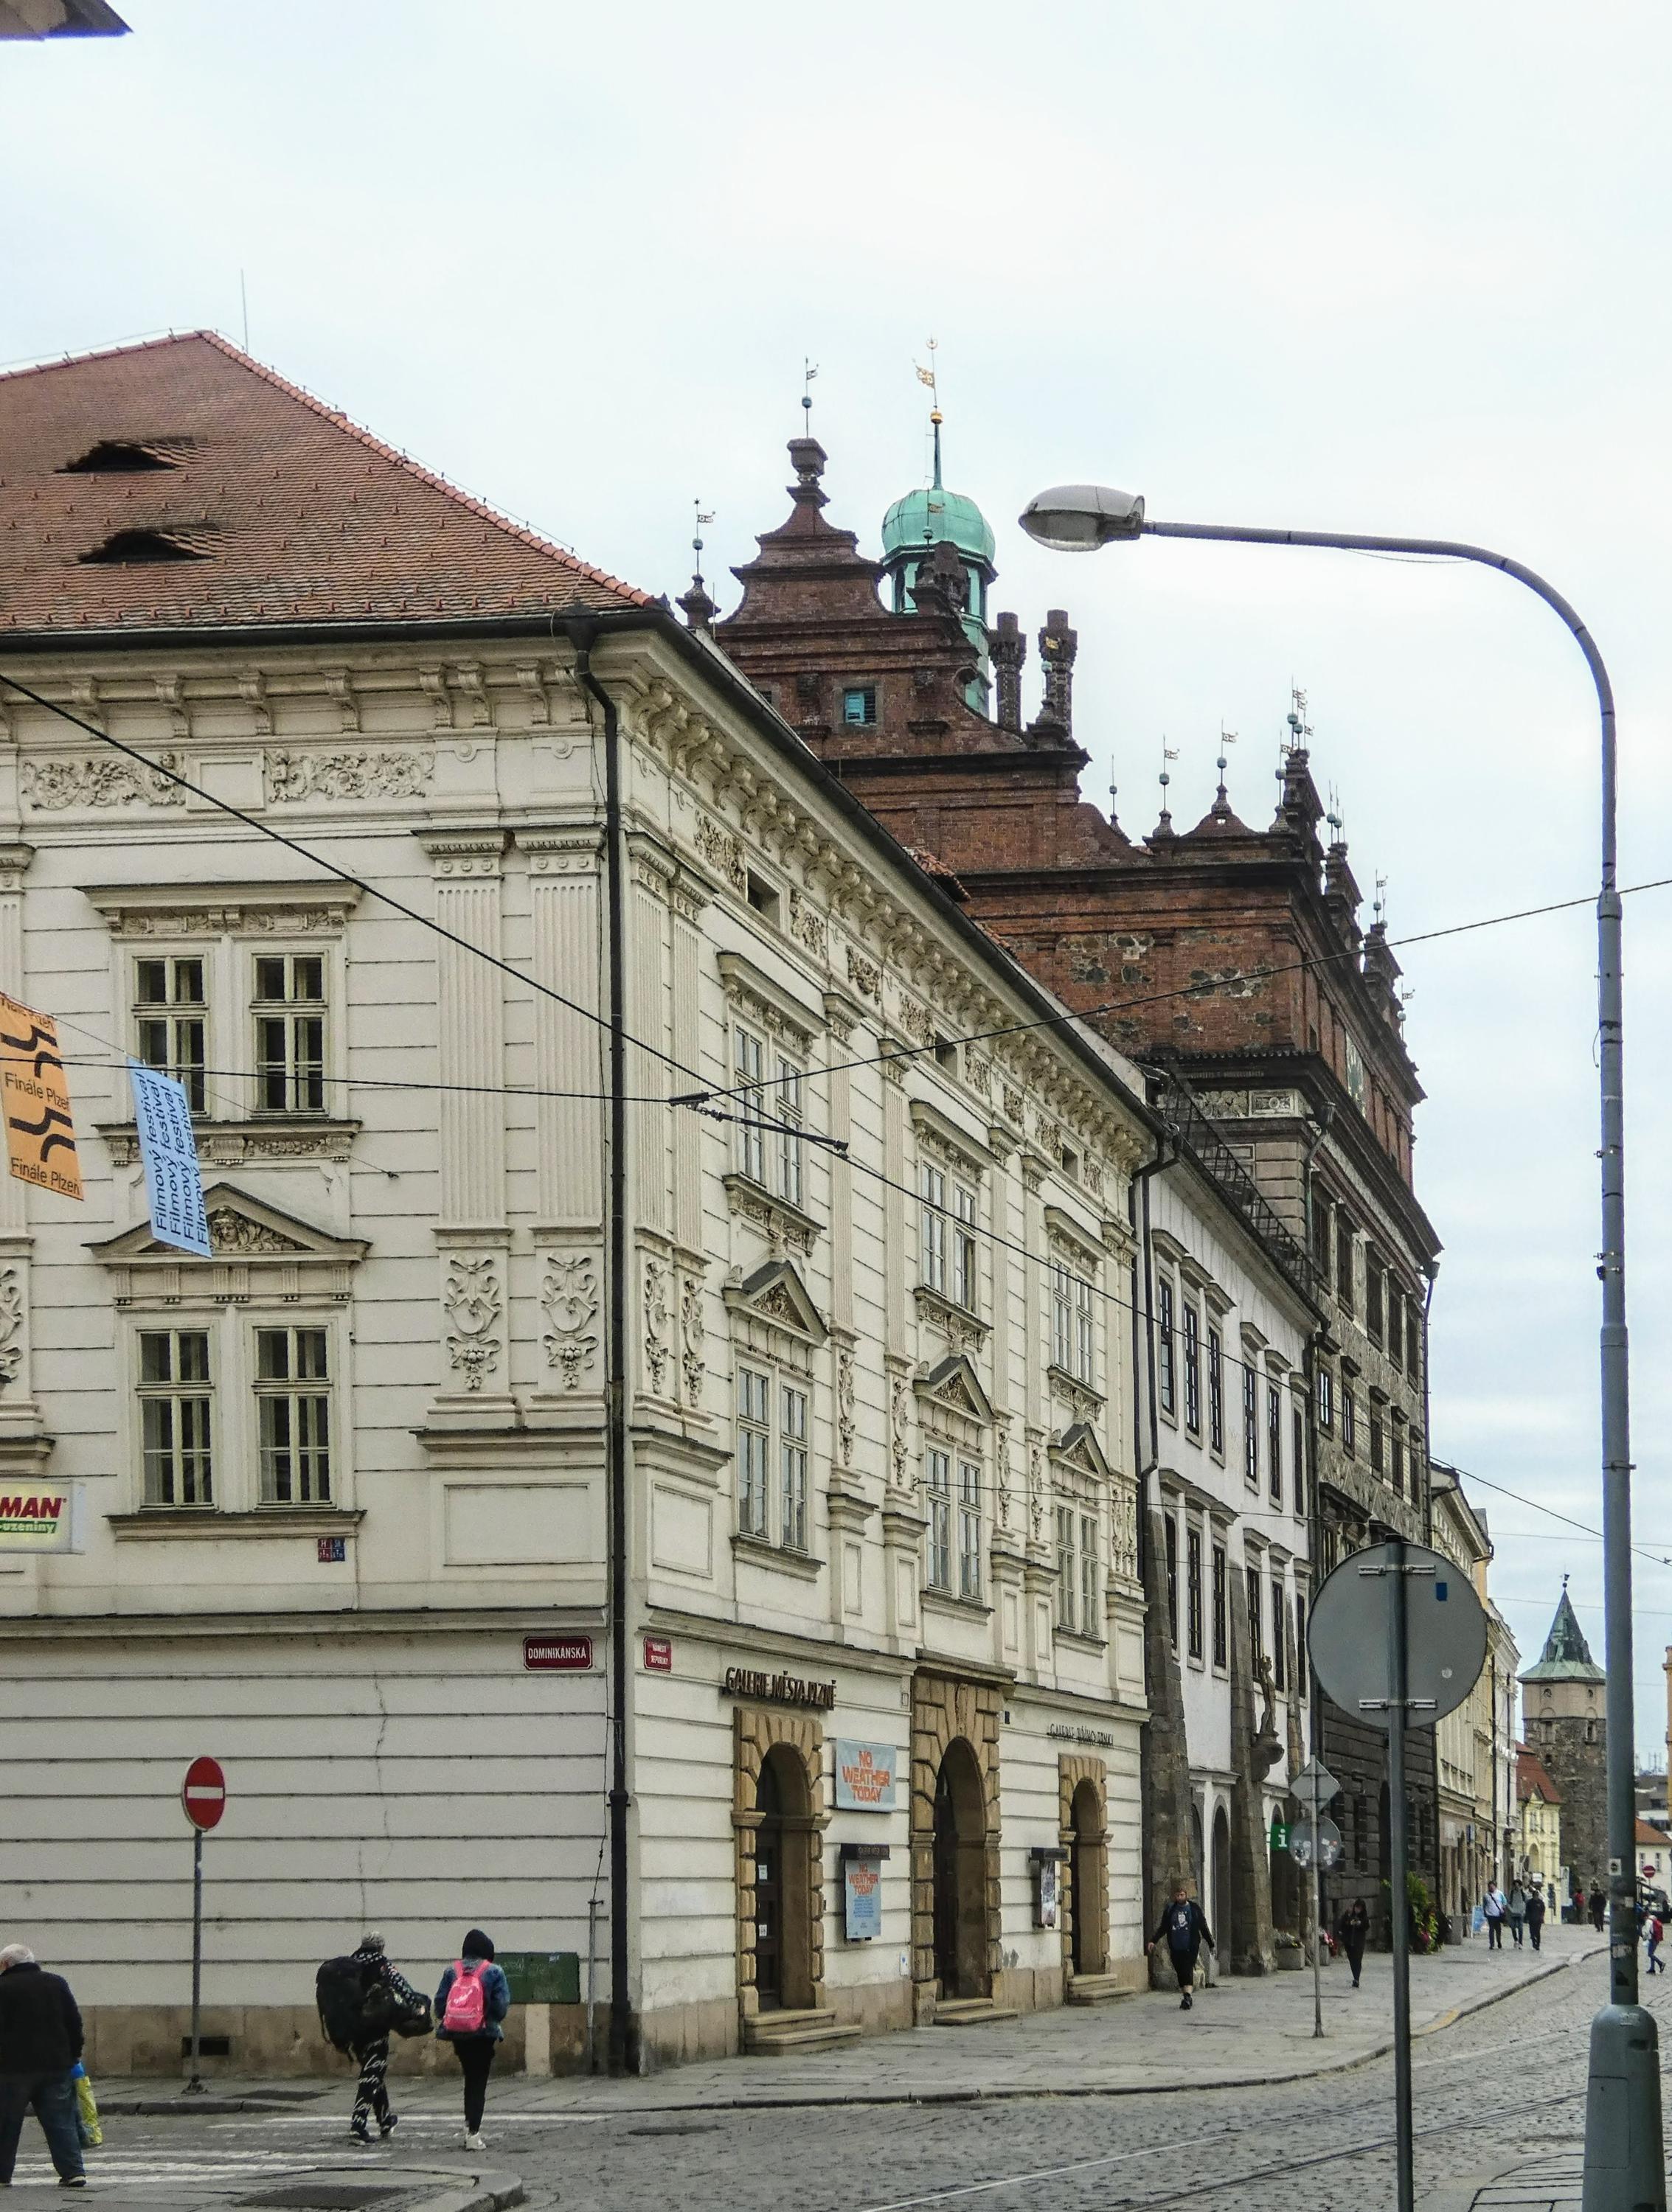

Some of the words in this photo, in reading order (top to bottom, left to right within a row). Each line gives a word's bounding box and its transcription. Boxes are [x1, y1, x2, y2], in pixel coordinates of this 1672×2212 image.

[4, 1072, 44, 1099] Finále
[135, 1072, 158, 1144] festival
[146, 1079, 171, 1150] festival
[160, 1085, 185, 1155] festival
[173, 1091, 197, 1160] festival
[11, 1157, 47, 1183] Finále
[148, 1150, 167, 1231] Filmový
[162, 1155, 181, 1236] Filmový
[177, 1161, 194, 1240] Filmový
[528, 1646, 586, 1660] DOMINIKÁNSKÁ
[726, 1666, 771, 1696] GALERIE
[771, 1671, 805, 1702] MĚSTA
[858, 1750, 873, 1768] NO
[842, 1766, 890, 1787] WEATHER
[850, 1784, 881, 1804] TODAY
[848, 1874, 878, 1885] WEATHER
[853, 1885, 874, 1896] TODAY
